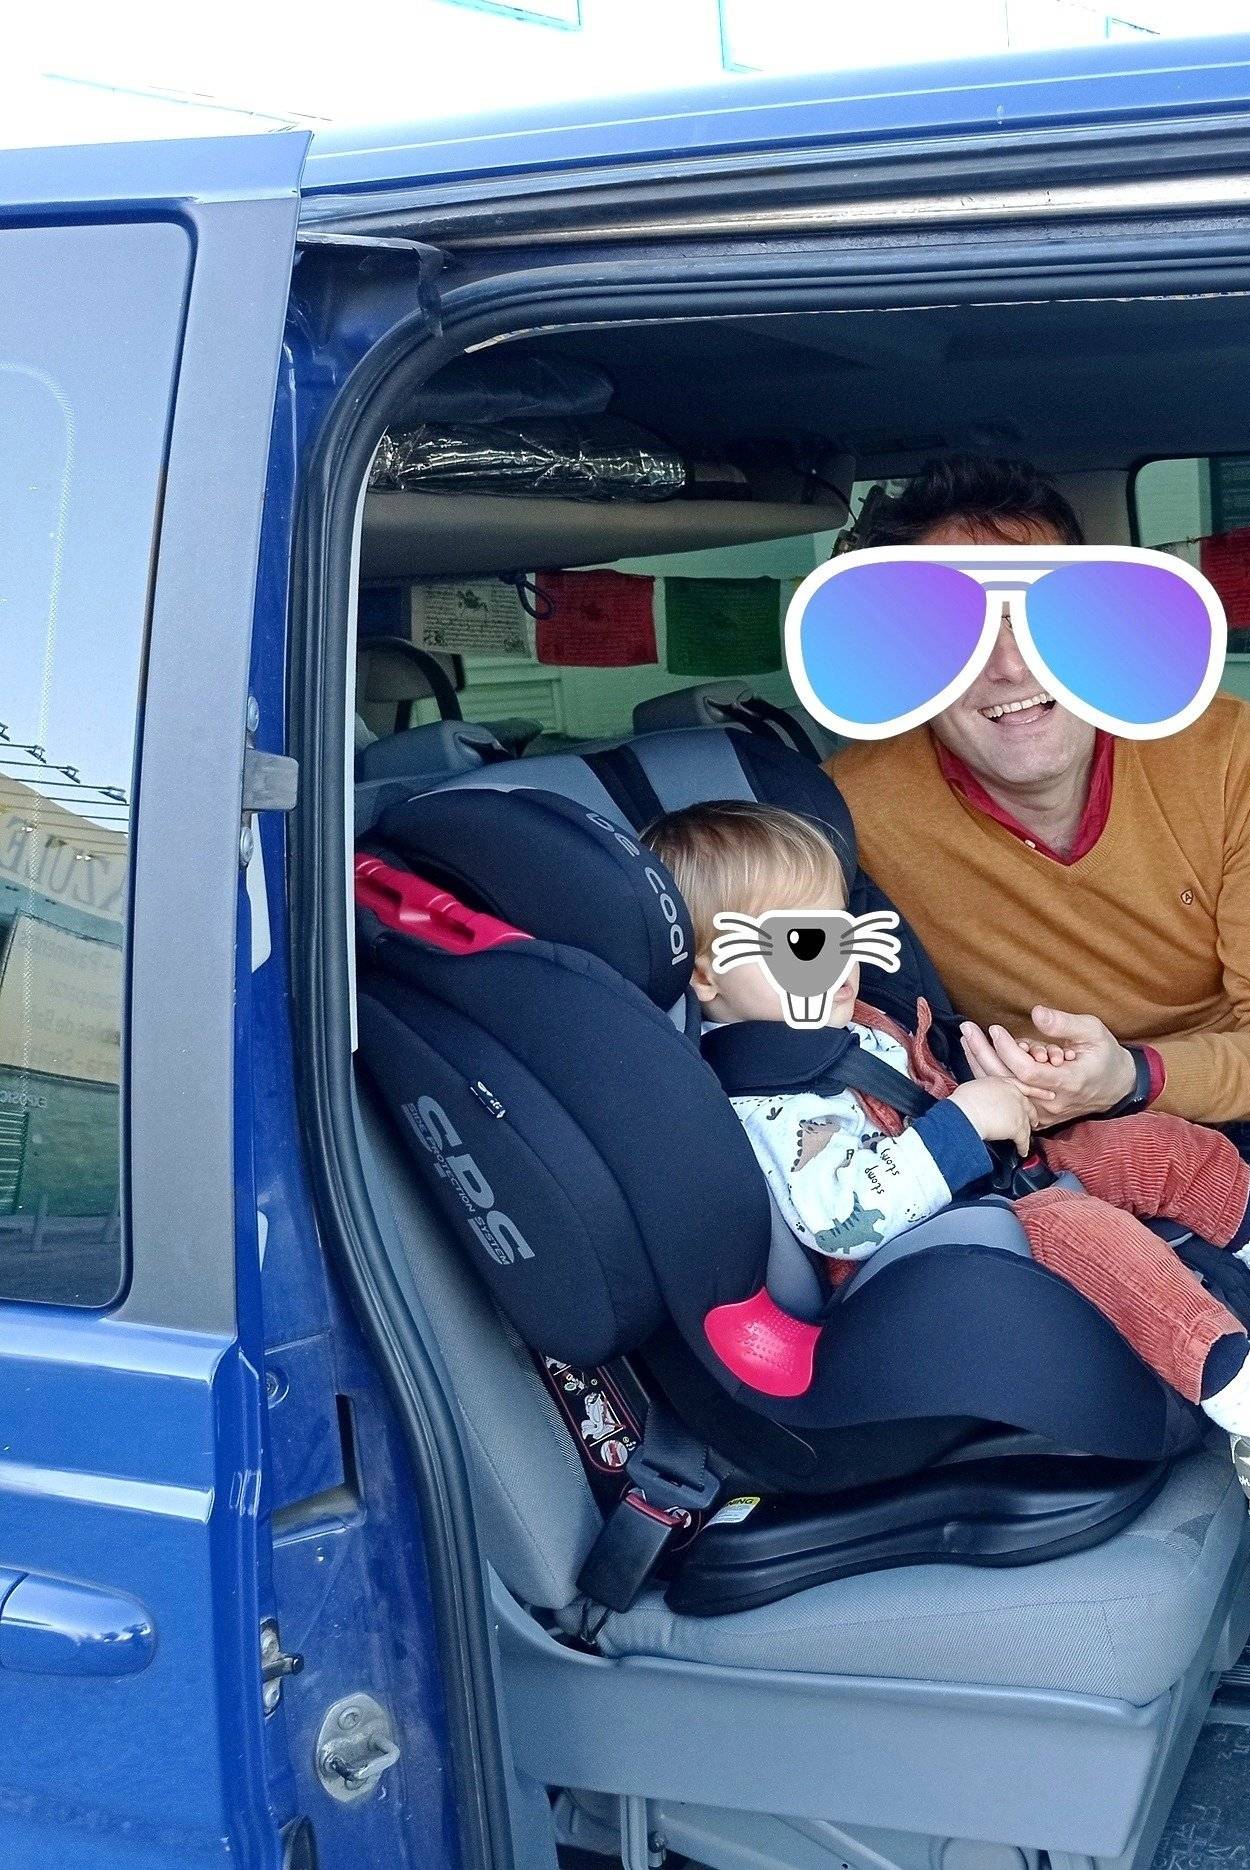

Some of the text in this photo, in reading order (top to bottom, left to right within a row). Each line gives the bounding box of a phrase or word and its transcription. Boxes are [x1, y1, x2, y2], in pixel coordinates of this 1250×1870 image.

[586, 813, 688, 966] be cool
[401, 1095, 536, 1266] SPS
[427, 1135, 476, 1212] PROTECTION
[474, 1216, 511, 1265] SYSTEM
